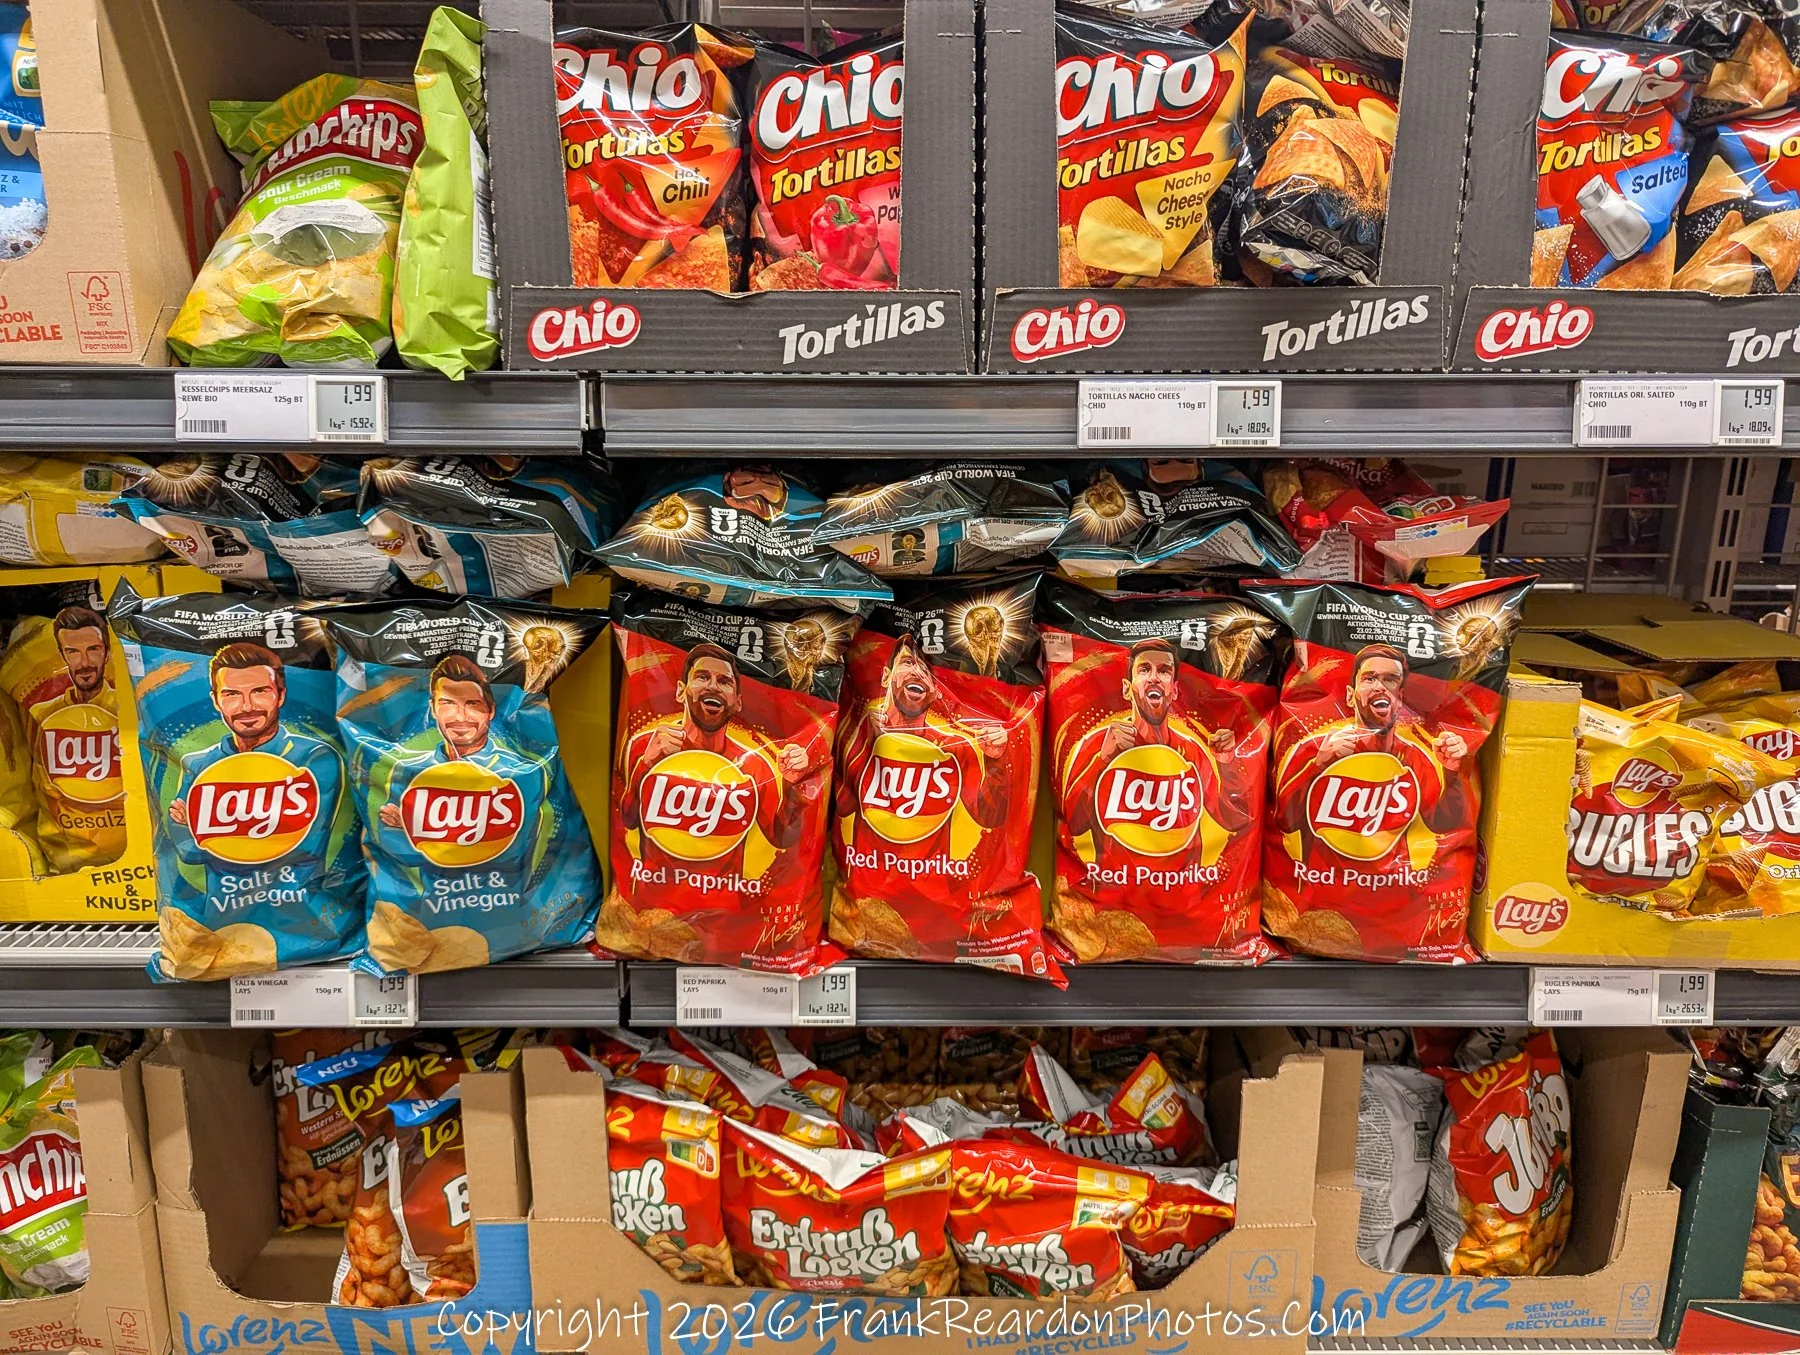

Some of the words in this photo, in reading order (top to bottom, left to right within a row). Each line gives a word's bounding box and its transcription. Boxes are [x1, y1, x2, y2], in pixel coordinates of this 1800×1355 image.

[759, 53, 904, 150] Chio
[1056, 53, 1212, 136] Chio
[562, 127, 685, 171] Tortillas
[1539, 126, 1662, 175] Tortillas
[674, 168, 700, 181] Hot
[1058, 135, 1186, 190] Tortillas
[295, 164, 351, 189] Cream
[771, 147, 901, 204] Tortillas
[1163, 171, 1212, 193] Nacho
[1632, 164, 1688, 195] Salted
[274, 179, 342, 205] Geschmack
[662, 177, 710, 204] Chili
[1164, 210, 1203, 231] Style
[88, 303, 112, 311] FSC
[531, 300, 637, 352] Chio
[778, 301, 946, 365] Tortillas
[1012, 301, 1121, 356] Chio
[1261, 295, 1429, 362] Tortillas
[1480, 300, 1590, 355] Chio
[274, 396, 292, 404] 125g
[344, 385, 372, 405] 1.99
[1178, 402, 1195, 410] 110g
[1242, 389, 1270, 410] 1.99
[1679, 401, 1696, 409] 110g
[1745, 389, 1772, 409] 1.99
[955, 469, 994, 479] WORLD
[1178, 502, 1219, 512] WORLD
[735, 535, 755, 546] CUP
[755, 543, 791, 557] WORLD
[159, 617, 192, 625] GEWINNE
[174, 609, 199, 620] FIFA
[201, 612, 246, 621] WORLD
[419, 617, 461, 630] WORLD
[664, 602, 686, 612] FIFA
[687, 608, 724, 624] WORLD
[725, 615, 743, 625] CUP
[1326, 603, 1348, 613] FIFA
[1349, 604, 1387, 619] WORLD
[1388, 612, 1410, 621] CUP
[863, 758, 954, 819] Lay's
[1615, 759, 1679, 793] Lay's
[195, 775, 312, 839] Lay's
[644, 776, 751, 838] Lay's
[1104, 770, 1199, 832] Lay's
[1314, 774, 1412, 837] Lay's
[411, 786, 517, 847] Lay's
[845, 846, 878, 871] Red
[884, 852, 969, 880] Paprika
[220, 871, 272, 895] Salt
[279, 866, 297, 883] &
[433, 874, 483, 898] Salt
[489, 871, 508, 888] &
[631, 859, 667, 885] Red
[674, 867, 762, 895] Paprika
[1086, 863, 1128, 886] Red
[1135, 864, 1218, 890] Paprika
[1294, 861, 1335, 886] Red
[1343, 868, 1430, 892] Paprika
[125, 884, 139, 897] &
[211, 886, 307, 914] Vinegar
[425, 890, 520, 915] Vinegar
[1497, 896, 1568, 934] Lay's
[315, 987, 332, 995] 150g
[379, 975, 404, 994] 1.99
[821, 975, 846, 993] 1.99
[1627, 988, 1639, 996] 75g
[1680, 976, 1704, 993] 1.99
[317, 1056, 359, 1078] NEU
[332, 1052, 446, 1122] Lorenz
[300, 1114, 334, 1136] Western
[316, 1138, 361, 1166] Erdnüssen
[24, 1217, 71, 1246] Cream
[750, 1207, 895, 1250] Erdnuß
[786, 1230, 921, 1279] Locken
[807, 1278, 844, 1287] Classic
[1308, 1273, 1512, 1337] Lorenz
[1523, 1302, 1546, 1314] SEE
[1549, 1300, 1575, 1310] YOU
[1527, 1311, 1558, 1320] AGAIN
[1559, 1309, 1590, 1317] SOON
[9, 1326, 35, 1339] SEE
[35, 1320, 64, 1335] YOU
[18, 1333, 50, 1345] AGAIN
[51, 1327, 82, 1339] SOON
[178, 1311, 332, 1355] Lorenz
[1505, 1316, 1607, 1331] #RECYCLABLE
[975, 1333, 1020, 1347] HAD
